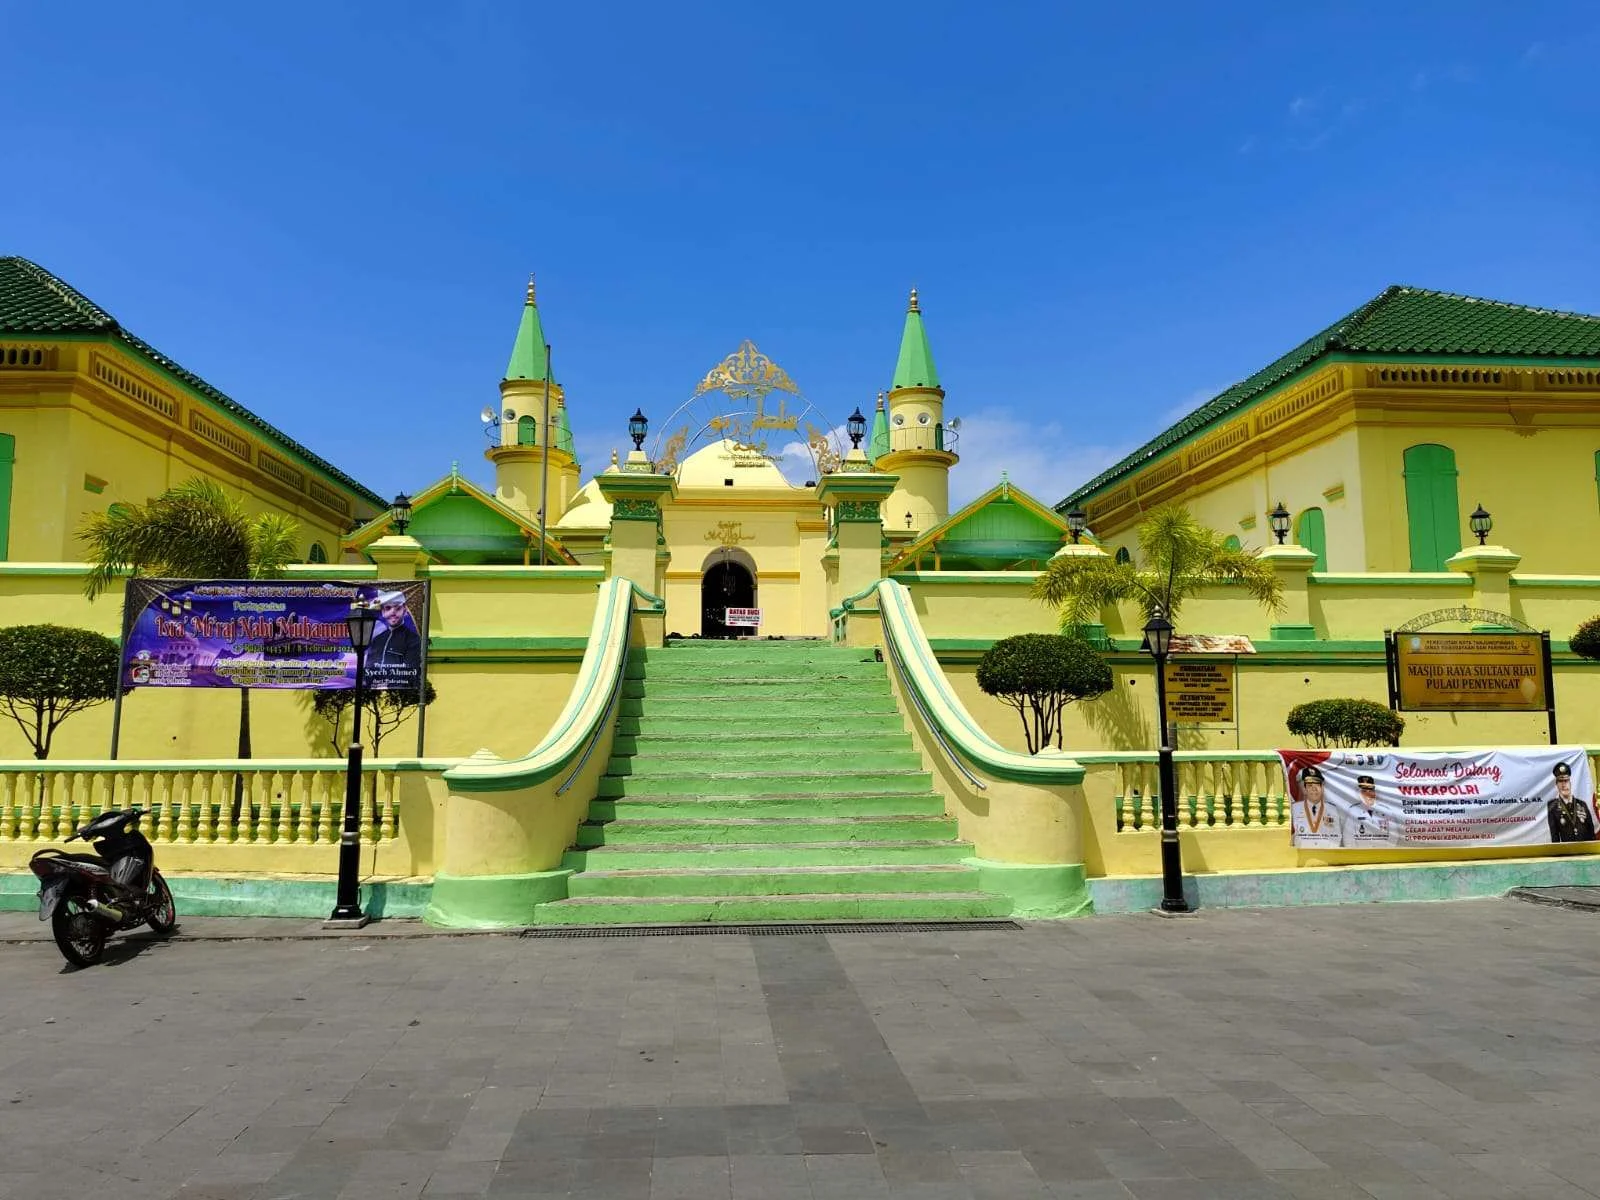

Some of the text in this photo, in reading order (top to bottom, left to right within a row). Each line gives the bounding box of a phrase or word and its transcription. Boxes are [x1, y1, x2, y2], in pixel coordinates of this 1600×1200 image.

[155, 615, 188, 637] Isra'
[191, 612, 236, 643] Mi'raj
[238, 616, 274, 640] Nabi
[1408, 665, 1537, 677] MASJID RAYA SULTAN RIAU
[1426, 679, 1520, 690] PULAU PENYENGAT
[1395, 761, 1501, 783] Selamat Datang
[1399, 785, 1480, 796] WAKAPOLRI
